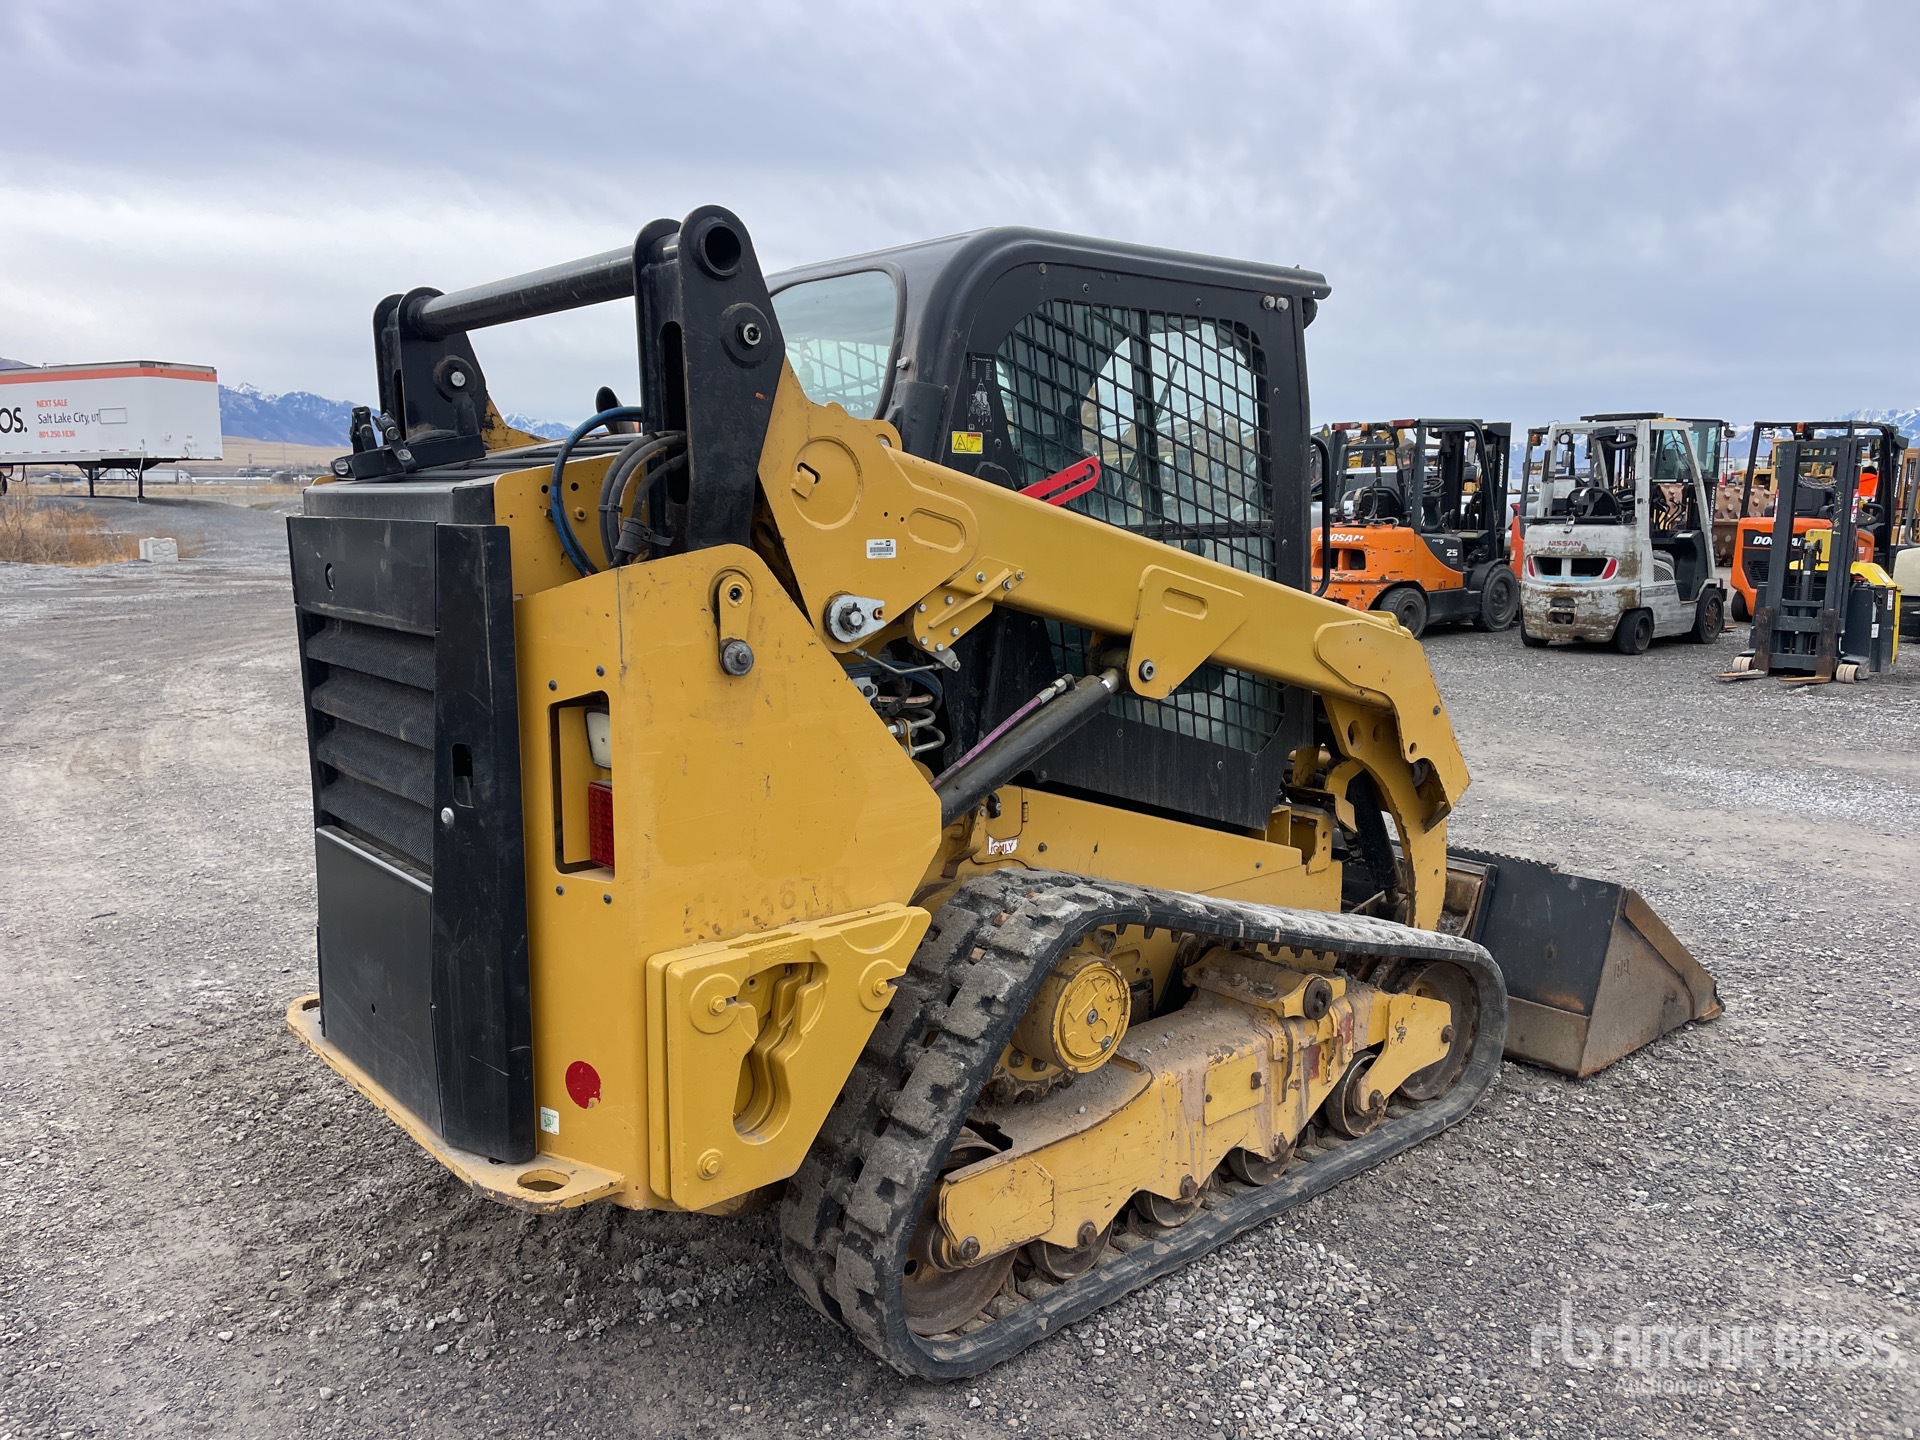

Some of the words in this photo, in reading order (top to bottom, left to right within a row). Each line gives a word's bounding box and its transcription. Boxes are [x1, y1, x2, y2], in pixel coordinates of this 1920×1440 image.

[53, 399, 68, 407] SALE
[38, 413, 53, 425] Salt
[54, 412, 72, 424] Lake
[91, 413, 100, 423] UT
[1446, 548, 1459, 557] 25
